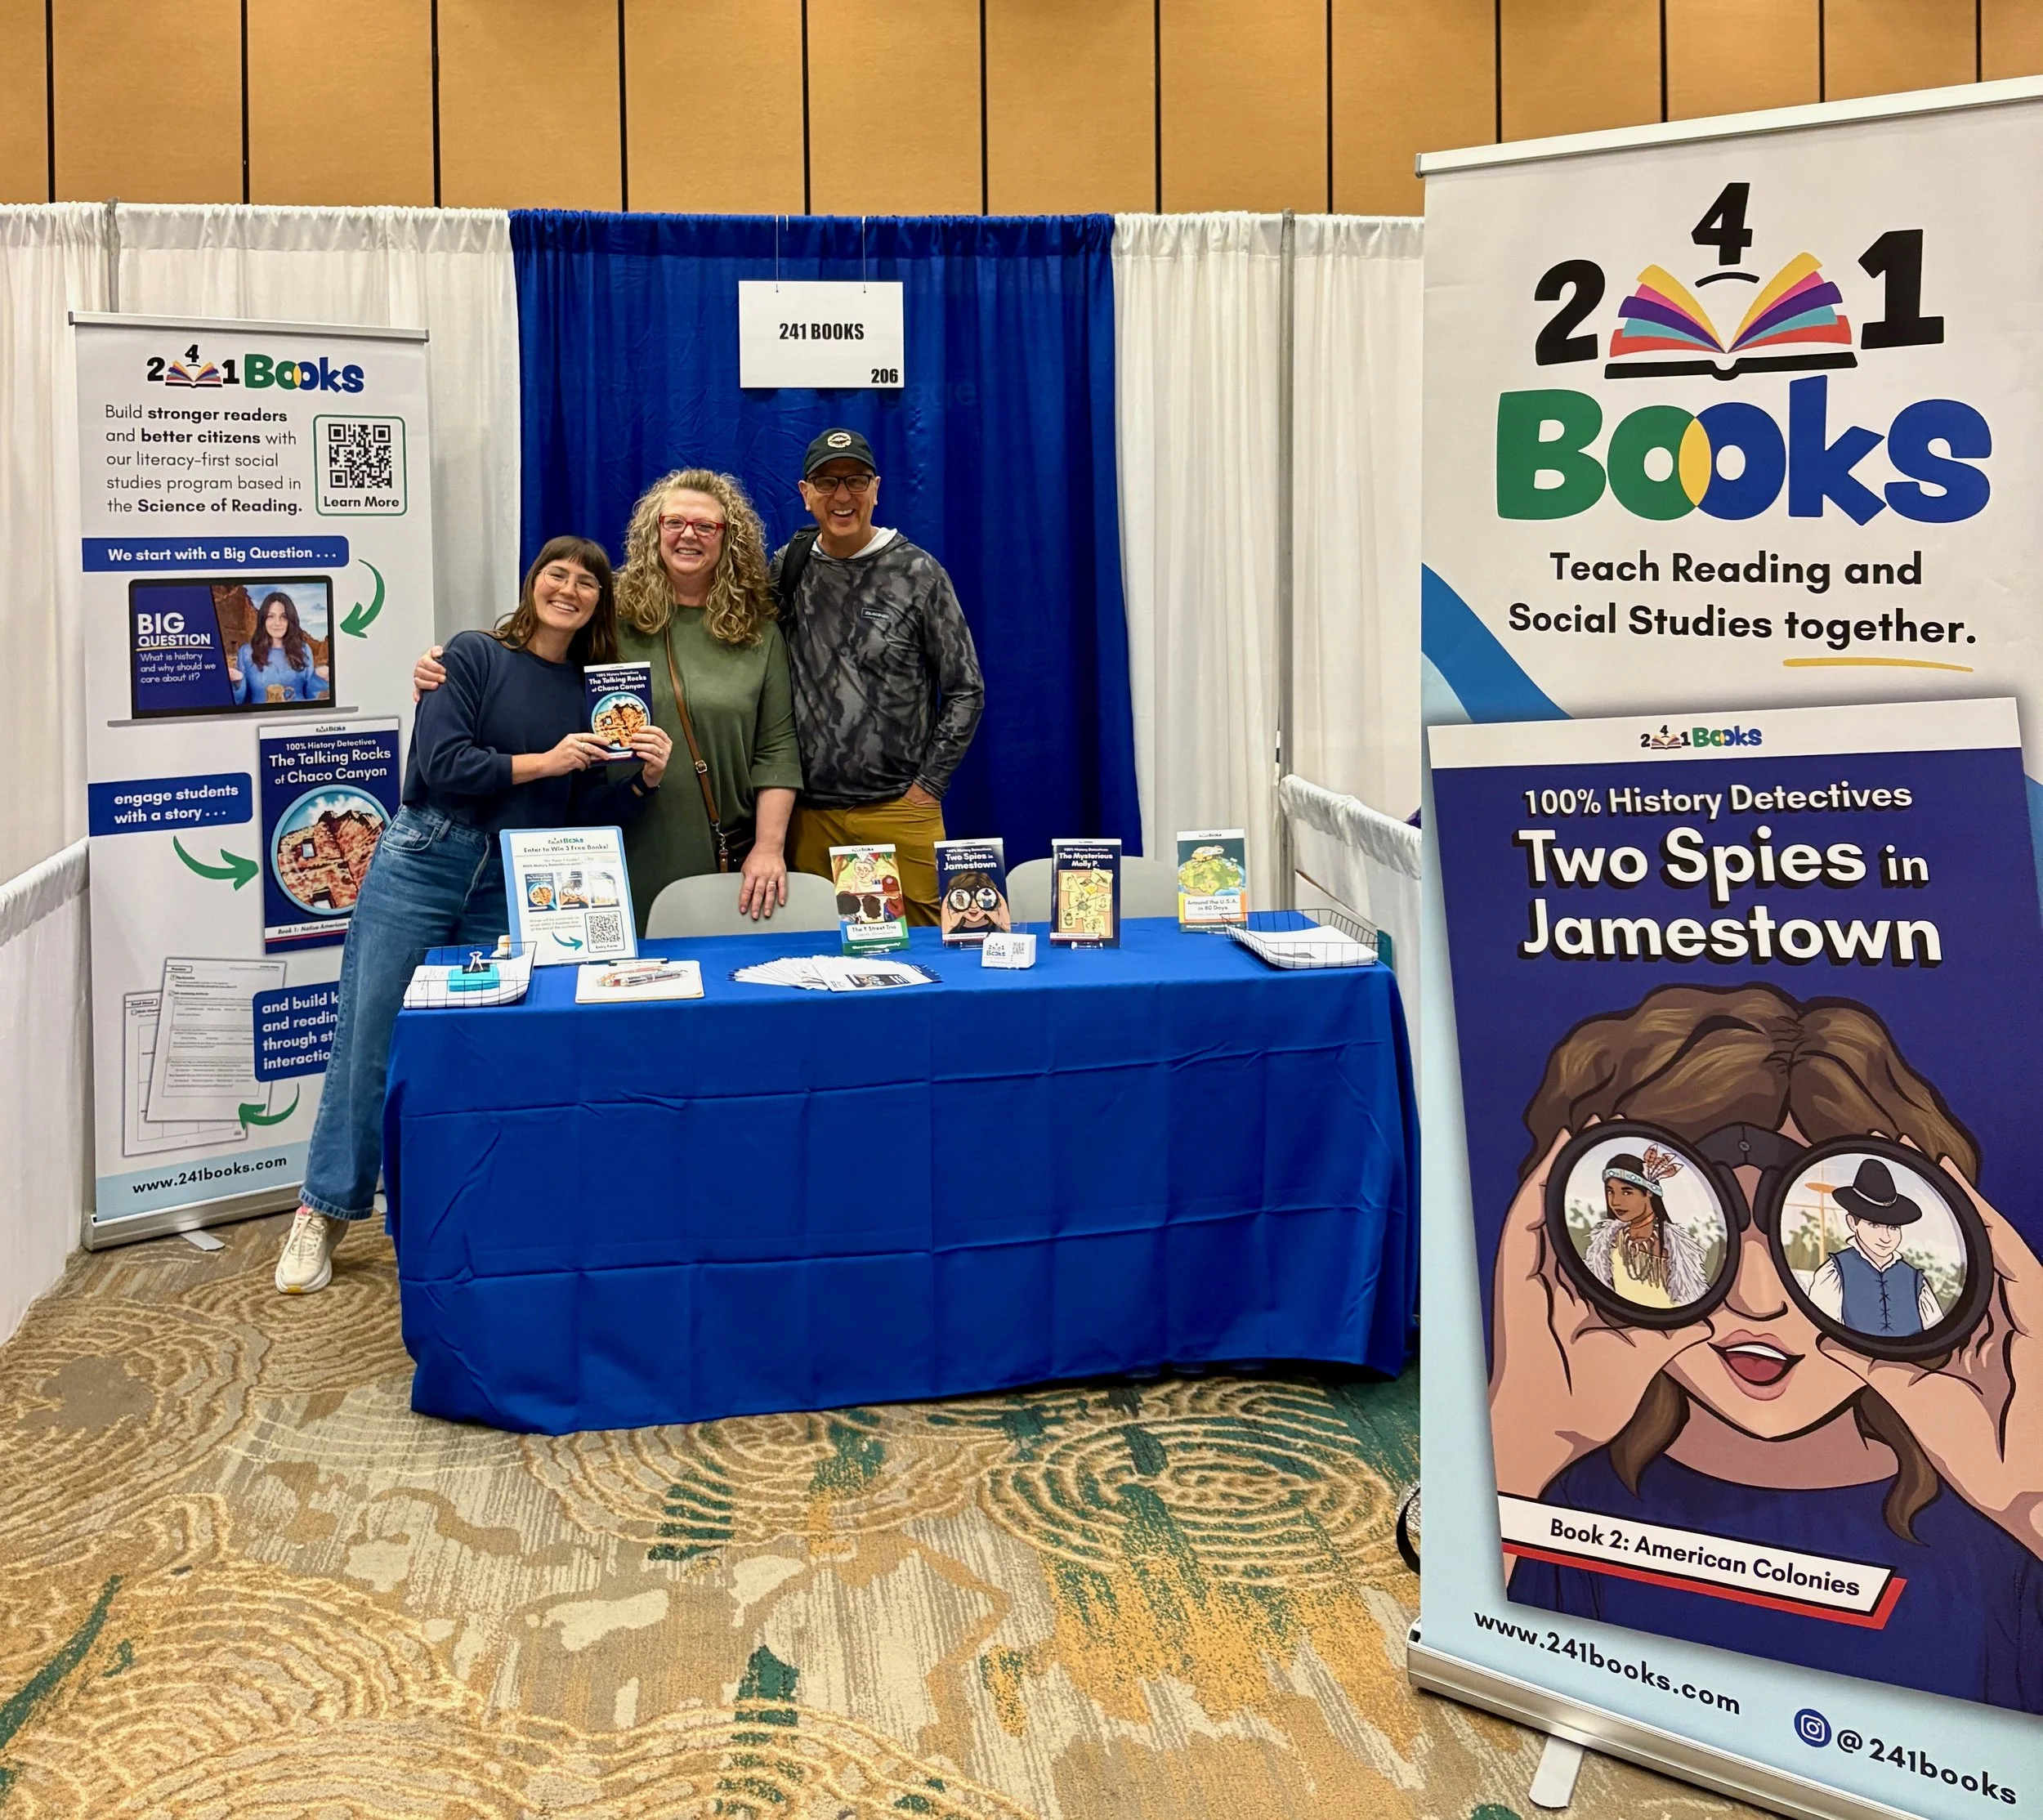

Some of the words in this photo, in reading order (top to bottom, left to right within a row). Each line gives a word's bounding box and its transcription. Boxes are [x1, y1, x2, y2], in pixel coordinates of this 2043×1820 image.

[780, 324, 806, 339] 241
[811, 324, 864, 339] BOOKS
[245, 353, 364, 393] Books
[871, 369, 898, 383] 206
[105, 405, 142, 419] Build
[148, 408, 219, 423] stronger
[224, 408, 287, 423] readers
[106, 428, 136, 442] and
[141, 428, 193, 444] better
[198, 431, 261, 445] citizens
[266, 432, 296, 445] with
[1496, 375, 1992, 525] Books
[107, 454, 131, 466] our
[137, 452, 230, 470] literacy-first
[235, 454, 278, 467] social
[107, 476, 161, 489] studies
[168, 478, 232, 493] program
[238, 476, 284, 490] based
[289, 477, 301, 489] in
[108, 499, 132, 512] the
[138, 499, 205, 512] Science
[211, 499, 227, 512] of
[232, 499, 302, 515] Reading.
[324, 496, 360, 508] Learn
[365, 496, 399, 508] More
[108, 548, 132, 561] We
[136, 548, 171, 561] start
[175, 547, 206, 560] with
[212, 551, 219, 560] a
[224, 547, 245, 561] Big
[250, 547, 312, 560] Question
[1550, 551, 1659, 584] Teach
[1672, 551, 1831, 593] Reading
[1845, 551, 1922, 585] and
[137, 612, 185, 633] BIG
[1509, 603, 1616, 635] Social
[1629, 605, 1772, 638] Studies
[1785, 610, 1976, 651] together.
[138, 633, 211, 646] QUESTION
[141, 652, 163, 662] What
[166, 652, 172, 660] is
[175, 652, 203, 663] history
[141, 664, 156, 673] and
[159, 664, 173, 674] why
[177, 662, 201, 671] should
[163, 673, 186, 682] about
[189, 673, 200, 681] it?
[338, 739, 376, 747] Detectives
[1692, 725, 1762, 747] Books
[269, 754, 295, 767] The
[298, 751, 348, 765] Talking
[352, 747, 391, 761] Rocks
[275, 775, 284, 785] of
[288, 770, 332, 783] Chaco
[336, 768, 387, 780] Canyon
[114, 790, 172, 807] engage
[176, 785, 238, 800] students
[1524, 788, 1602, 816] 100%
[1610, 785, 1721, 819] History
[1731, 780, 1912, 813] Detectives
[114, 808, 147, 824] with
[151, 812, 161, 821] a
[165, 807, 201, 822] story
[944, 861, 996, 870] Jamestown
[963, 852, 986, 861] Spies
[1514, 829, 1648, 886] Two
[1663, 826, 1866, 904] Spies
[1883, 845, 1929, 884] in
[1521, 899, 1942, 964] Jamestown
[262, 999, 288, 1013] and
[293, 992, 327, 1009] build
[262, 1017, 288, 1032] and
[293, 1011, 338, 1027] readin
[263, 1031, 316, 1051] through
[263, 1050, 331, 1069] interactio
[132, 1156, 287, 1193] www.241books.com
[1550, 1518, 1605, 1546] Book
[1610, 1528, 1629, 1552] 2:
[1635, 1536, 1746, 1576] American
[1755, 1558, 1860, 1596] Colonies
[1474, 1611, 1741, 1715] www.241books.com
